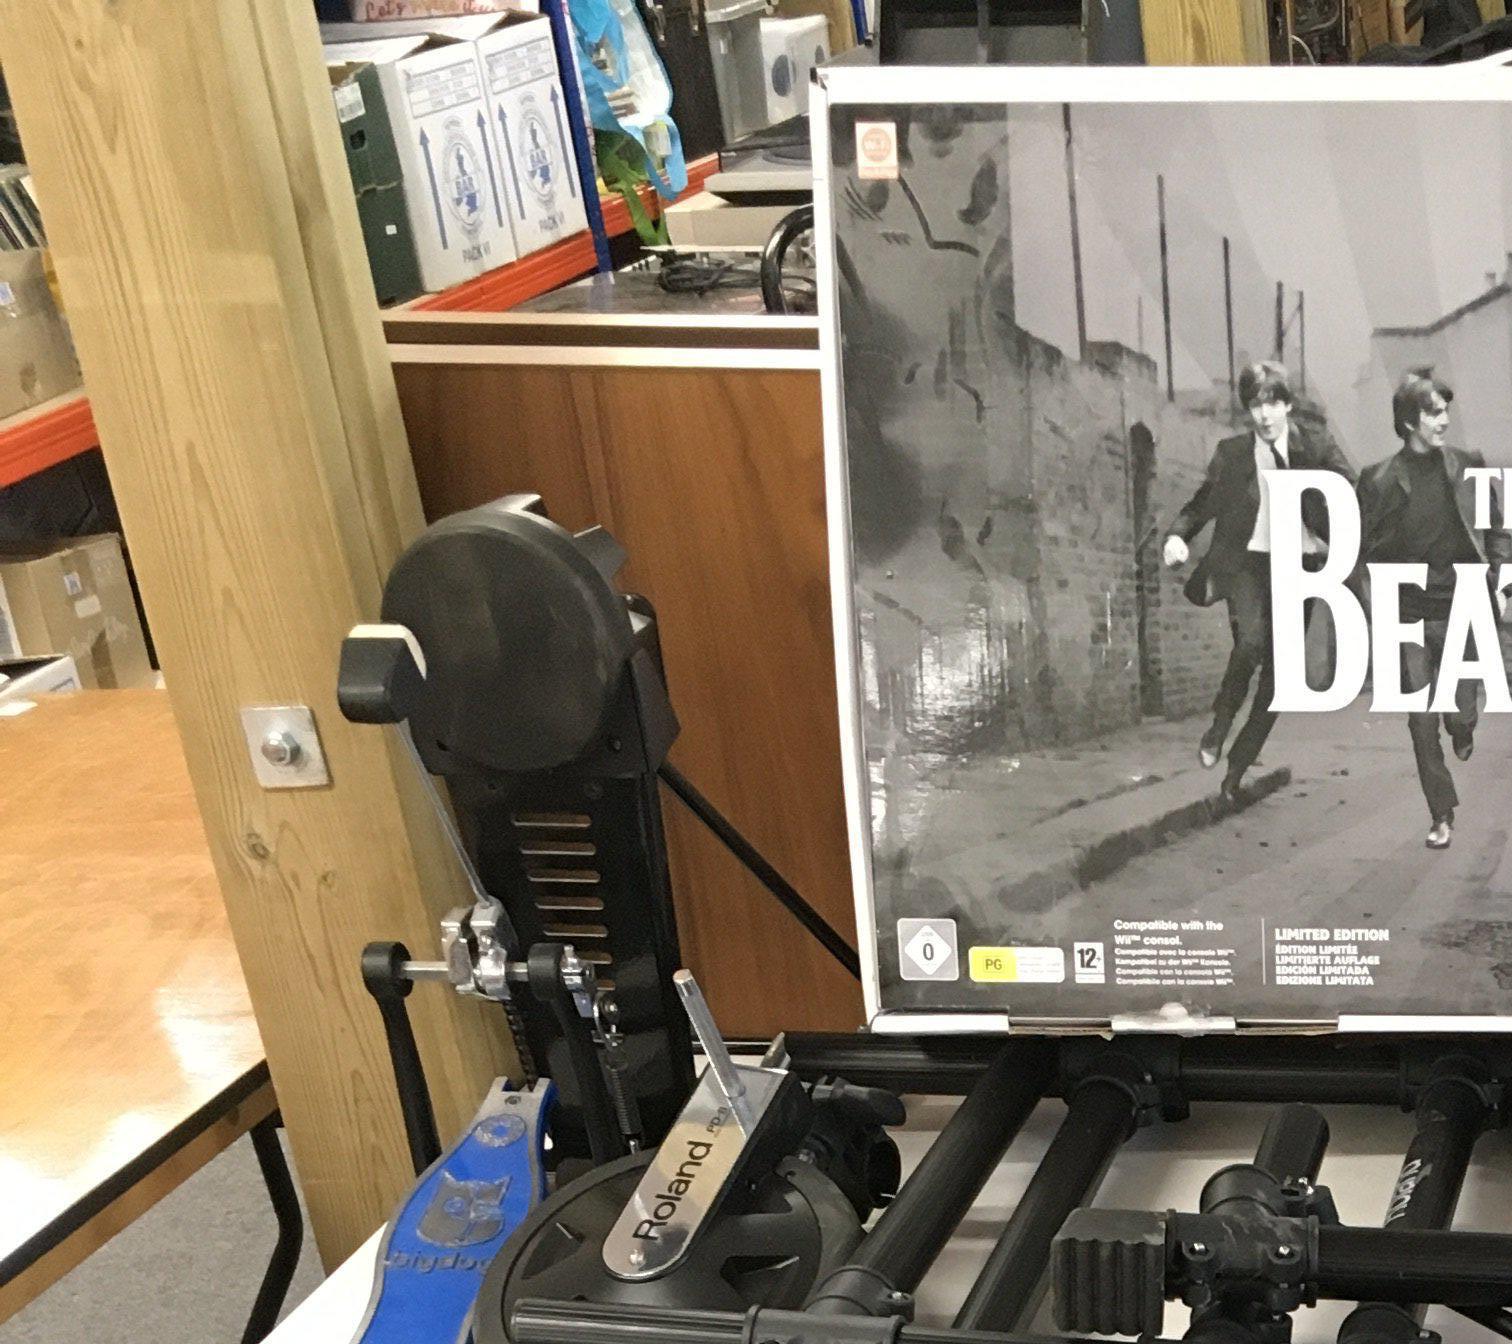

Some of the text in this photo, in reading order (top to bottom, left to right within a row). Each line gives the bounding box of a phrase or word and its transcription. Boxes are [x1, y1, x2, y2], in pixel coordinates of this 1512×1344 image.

[1113, 919, 1224, 932] Compatible with the
[1274, 928, 1390, 941] LIMITED EDITION
[984, 957, 1003, 971] PG
[1333, 955, 1380, 965] AUFLAGE
[1319, 965, 1370, 975] LIMITADA
[1276, 976, 1374, 986] EDIZIONE LIMITATA
[631, 1140, 714, 1242] Roland
